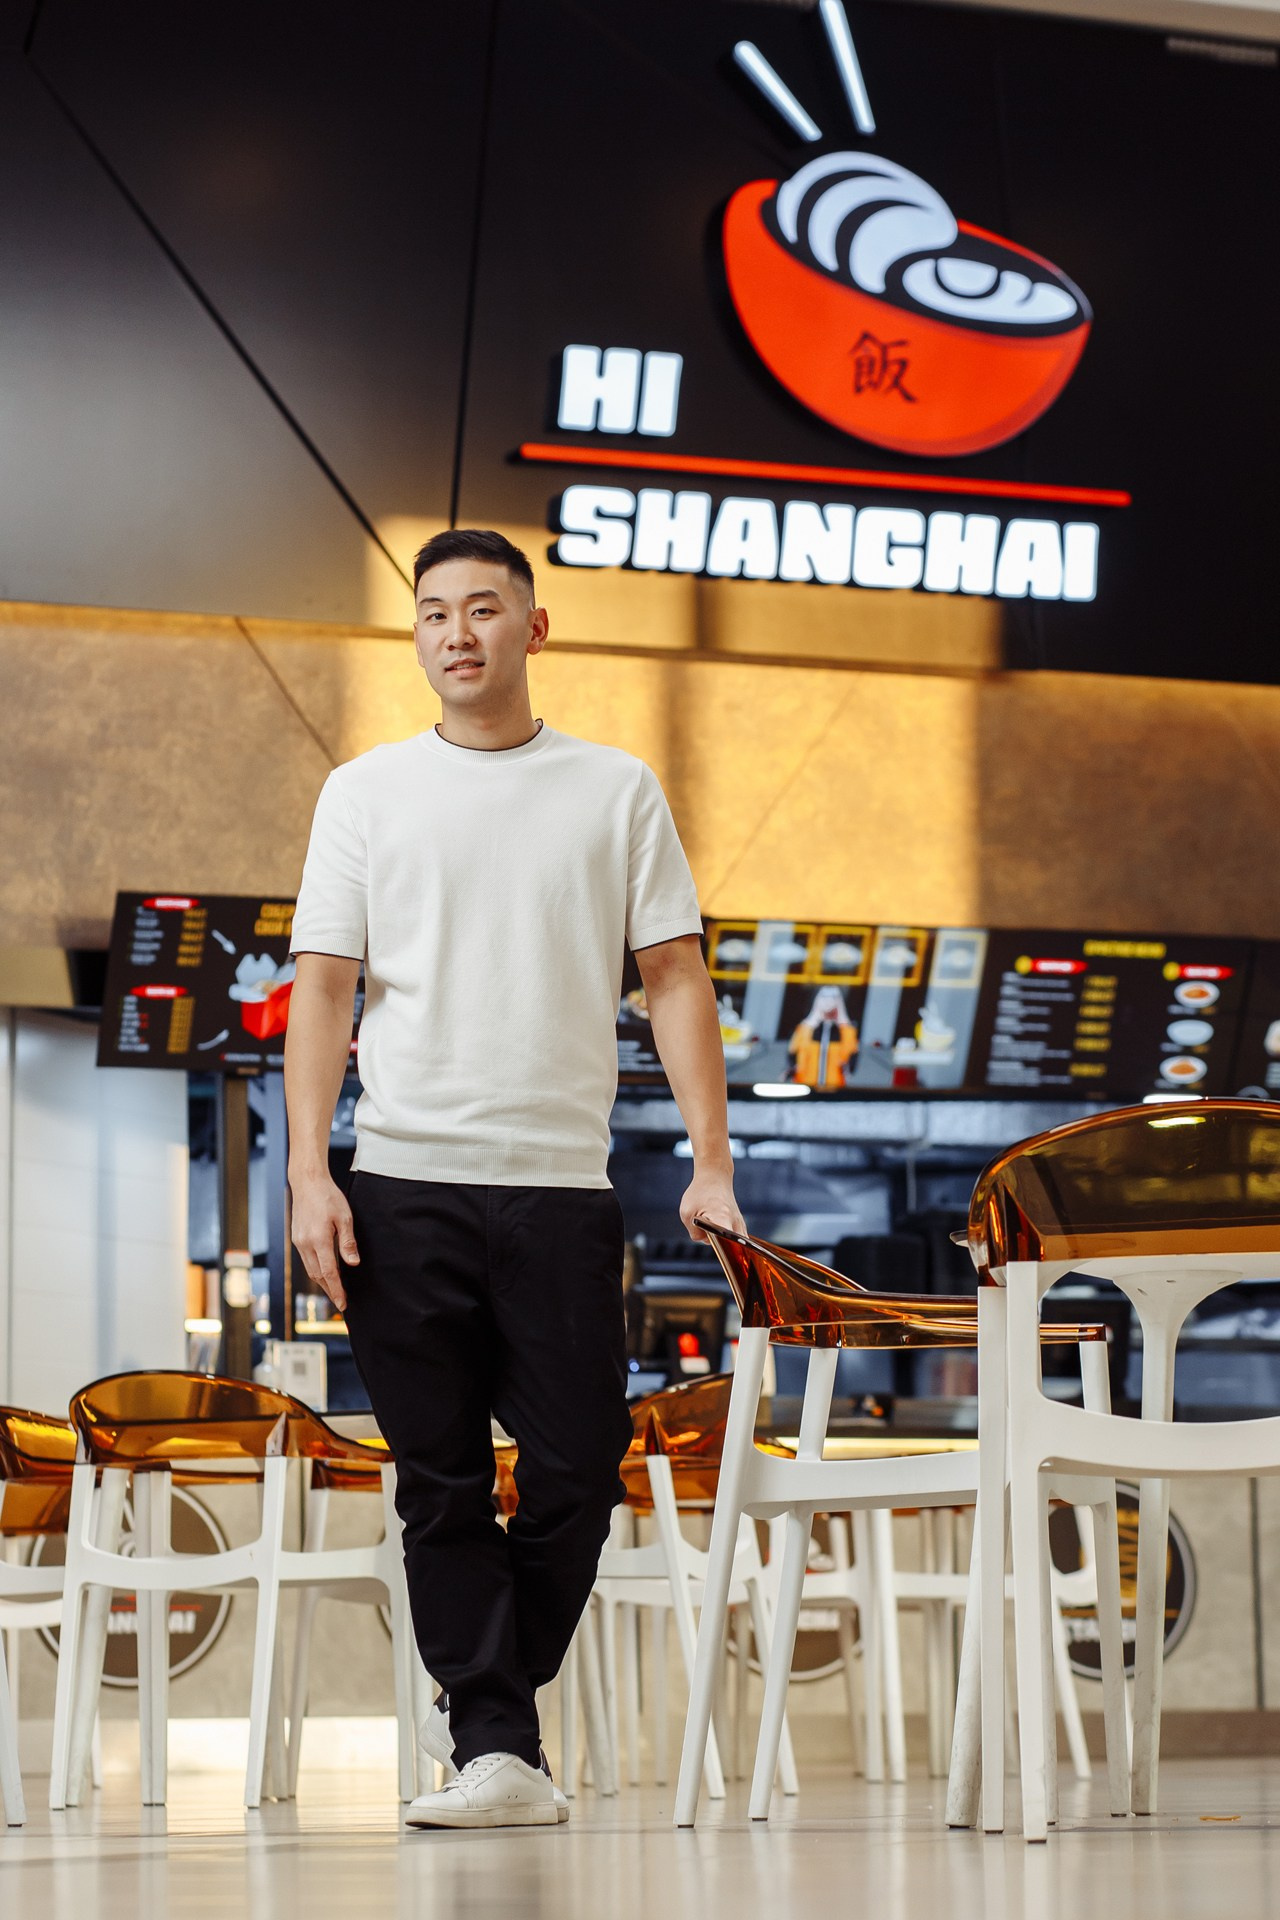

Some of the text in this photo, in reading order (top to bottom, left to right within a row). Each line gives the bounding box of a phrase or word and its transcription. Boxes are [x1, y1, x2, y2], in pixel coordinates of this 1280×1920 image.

[557, 344, 683, 437] HI
[848, 331, 917, 403] 飯
[557, 485, 1100, 602] SHANGHAI
